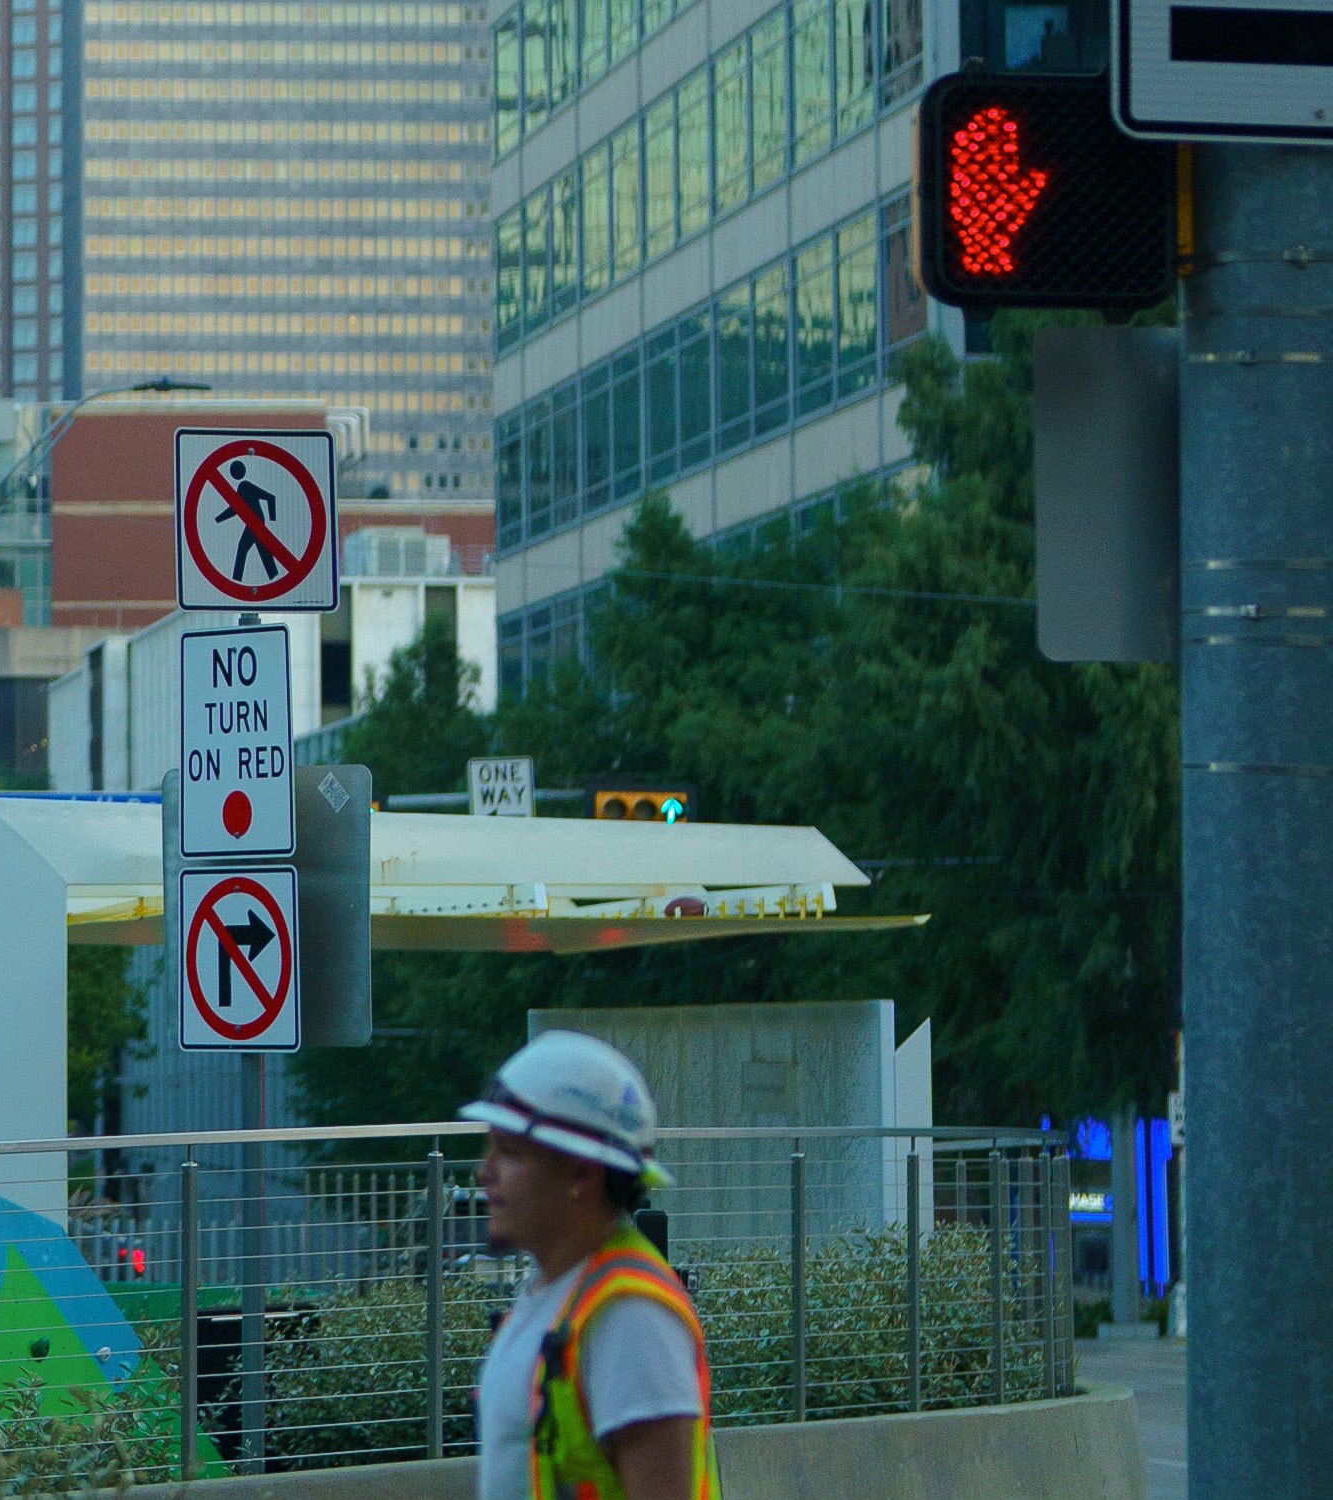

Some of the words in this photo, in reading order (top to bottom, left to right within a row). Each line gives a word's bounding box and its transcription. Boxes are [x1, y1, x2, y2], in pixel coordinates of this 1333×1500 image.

[212, 646, 257, 688] NO
[204, 699, 268, 735] TURN
[188, 748, 220, 782] ON
[238, 745, 285, 780] RED
[479, 764, 523, 784] ONE
[482, 784, 525, 807] WAY
